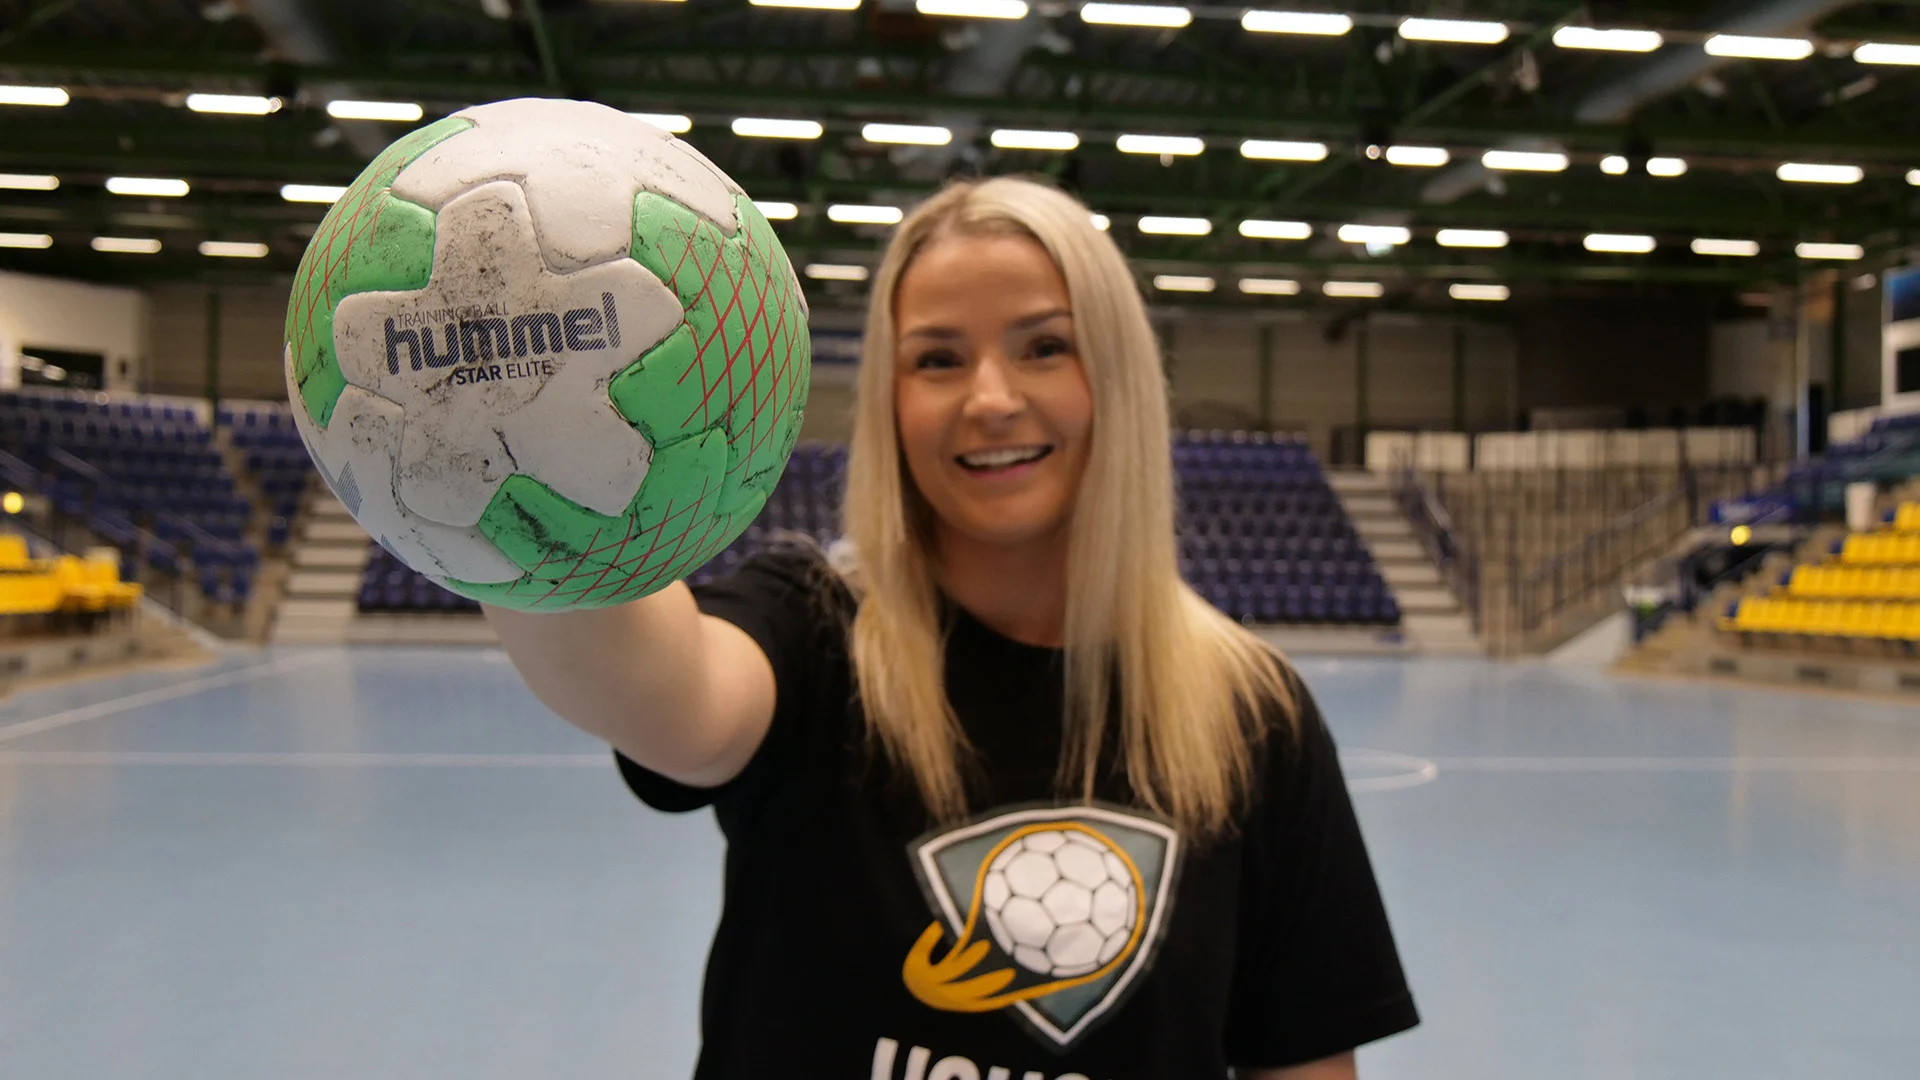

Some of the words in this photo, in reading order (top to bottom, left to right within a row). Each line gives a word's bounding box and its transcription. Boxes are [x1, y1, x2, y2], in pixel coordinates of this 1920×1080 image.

[397, 306, 470, 328] TRAINING
[472, 302, 510, 318] BALL
[384, 291, 622, 375] hummel
[455, 364, 502, 385] STAR
[506, 360, 555, 378] ELITE
